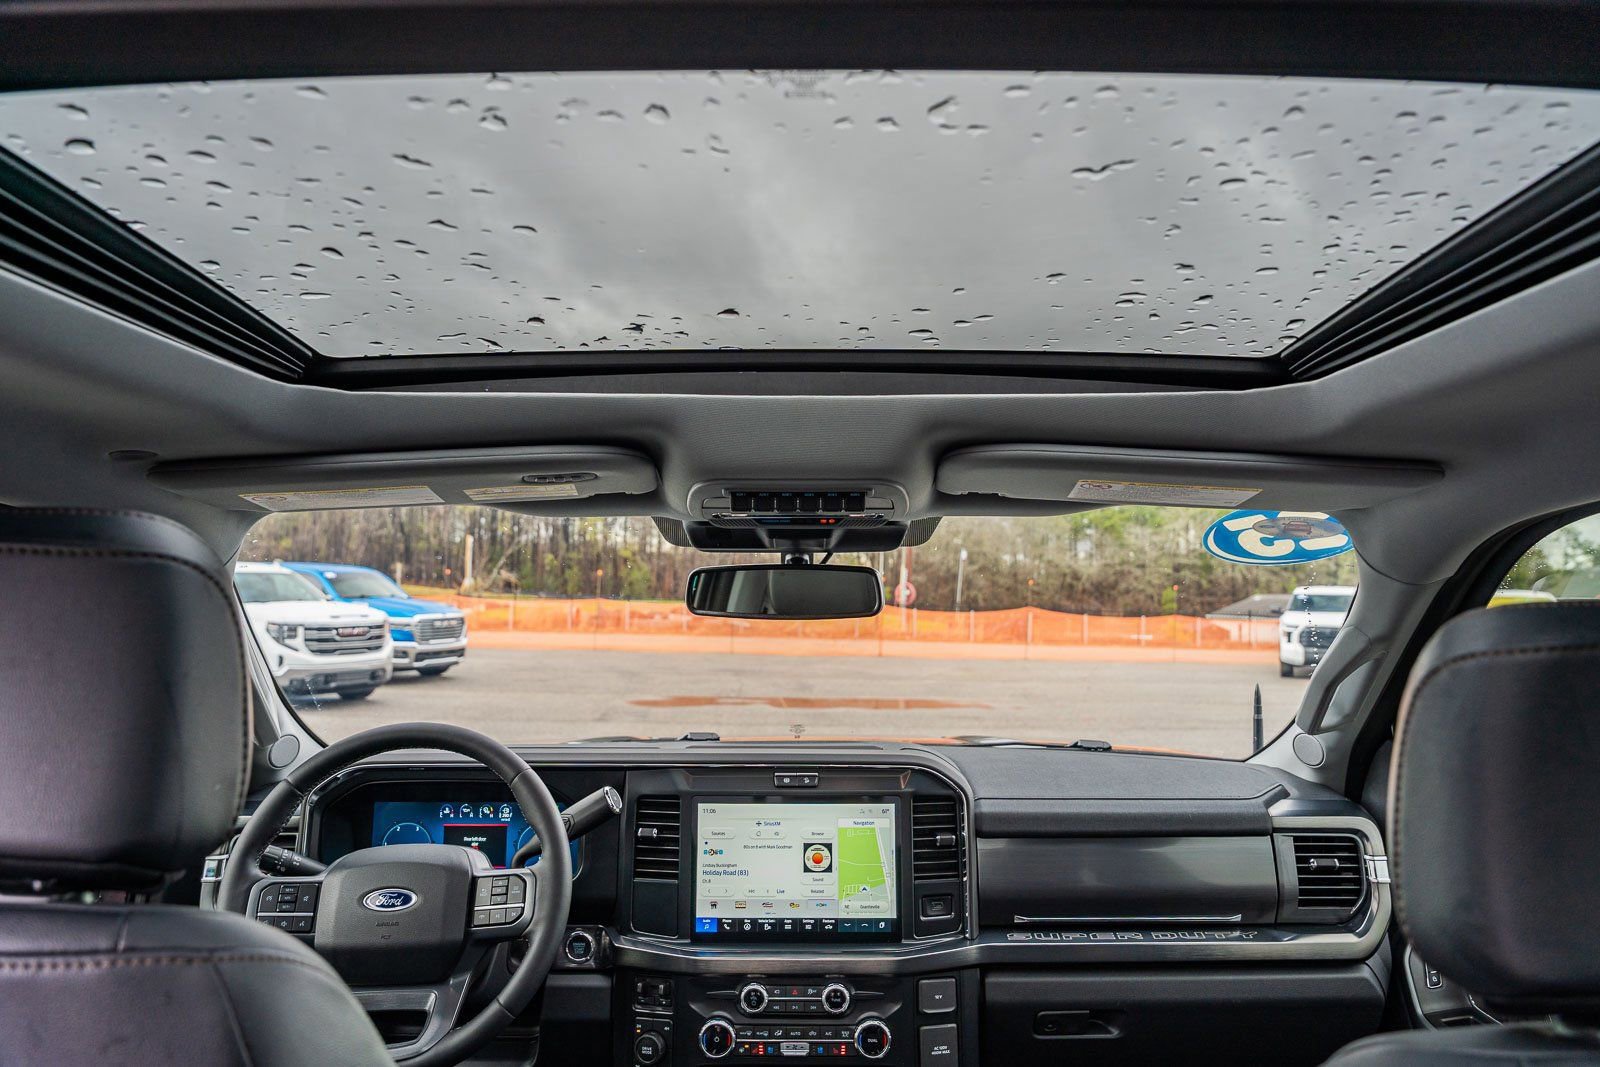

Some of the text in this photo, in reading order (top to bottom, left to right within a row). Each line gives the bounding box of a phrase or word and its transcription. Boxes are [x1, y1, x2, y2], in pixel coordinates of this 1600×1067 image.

[702, 869, 722, 877] Holiday
[737, 869, 749, 877] (83)
[375, 892, 404, 907] Ford
[1007, 930, 1258, 941] SUPER DUTY
